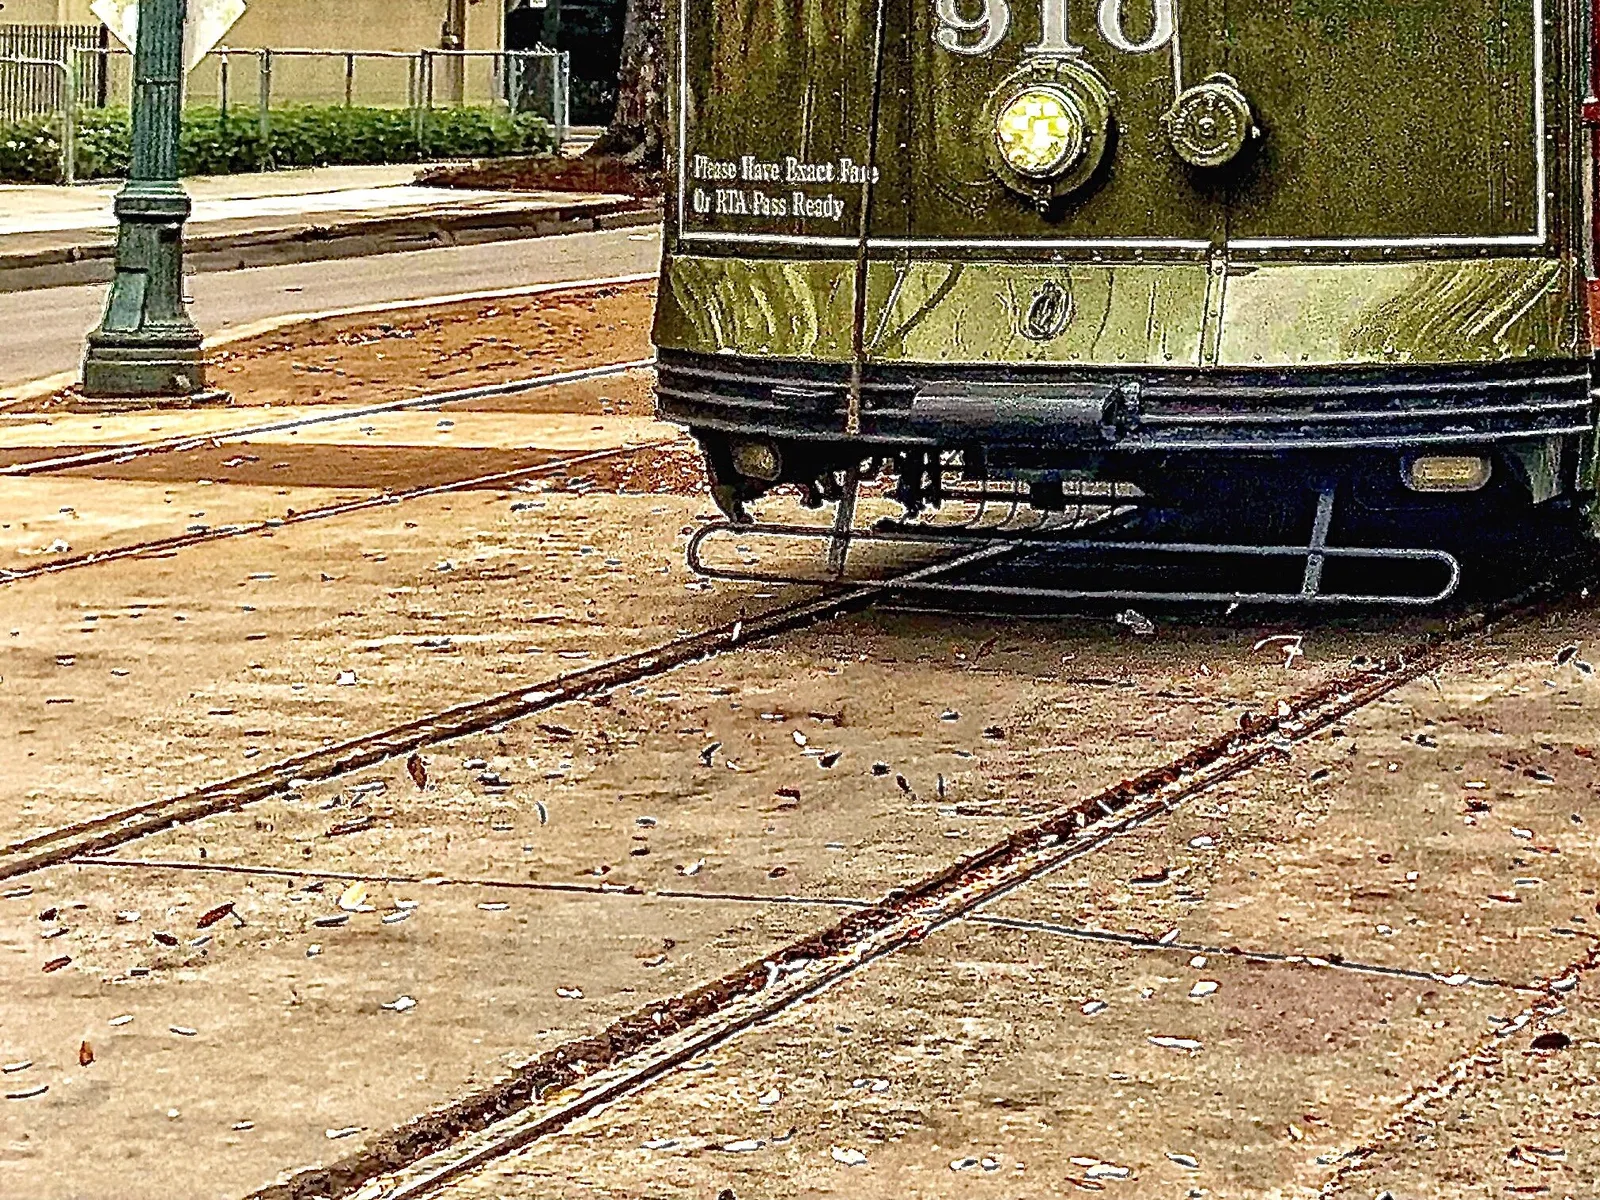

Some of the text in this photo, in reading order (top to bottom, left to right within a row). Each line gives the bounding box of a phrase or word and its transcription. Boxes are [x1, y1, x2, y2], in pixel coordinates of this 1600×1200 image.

[693, 154, 880, 185] Please Have Exact Fare
[693, 187, 846, 222] Or RTA Pass Ready
